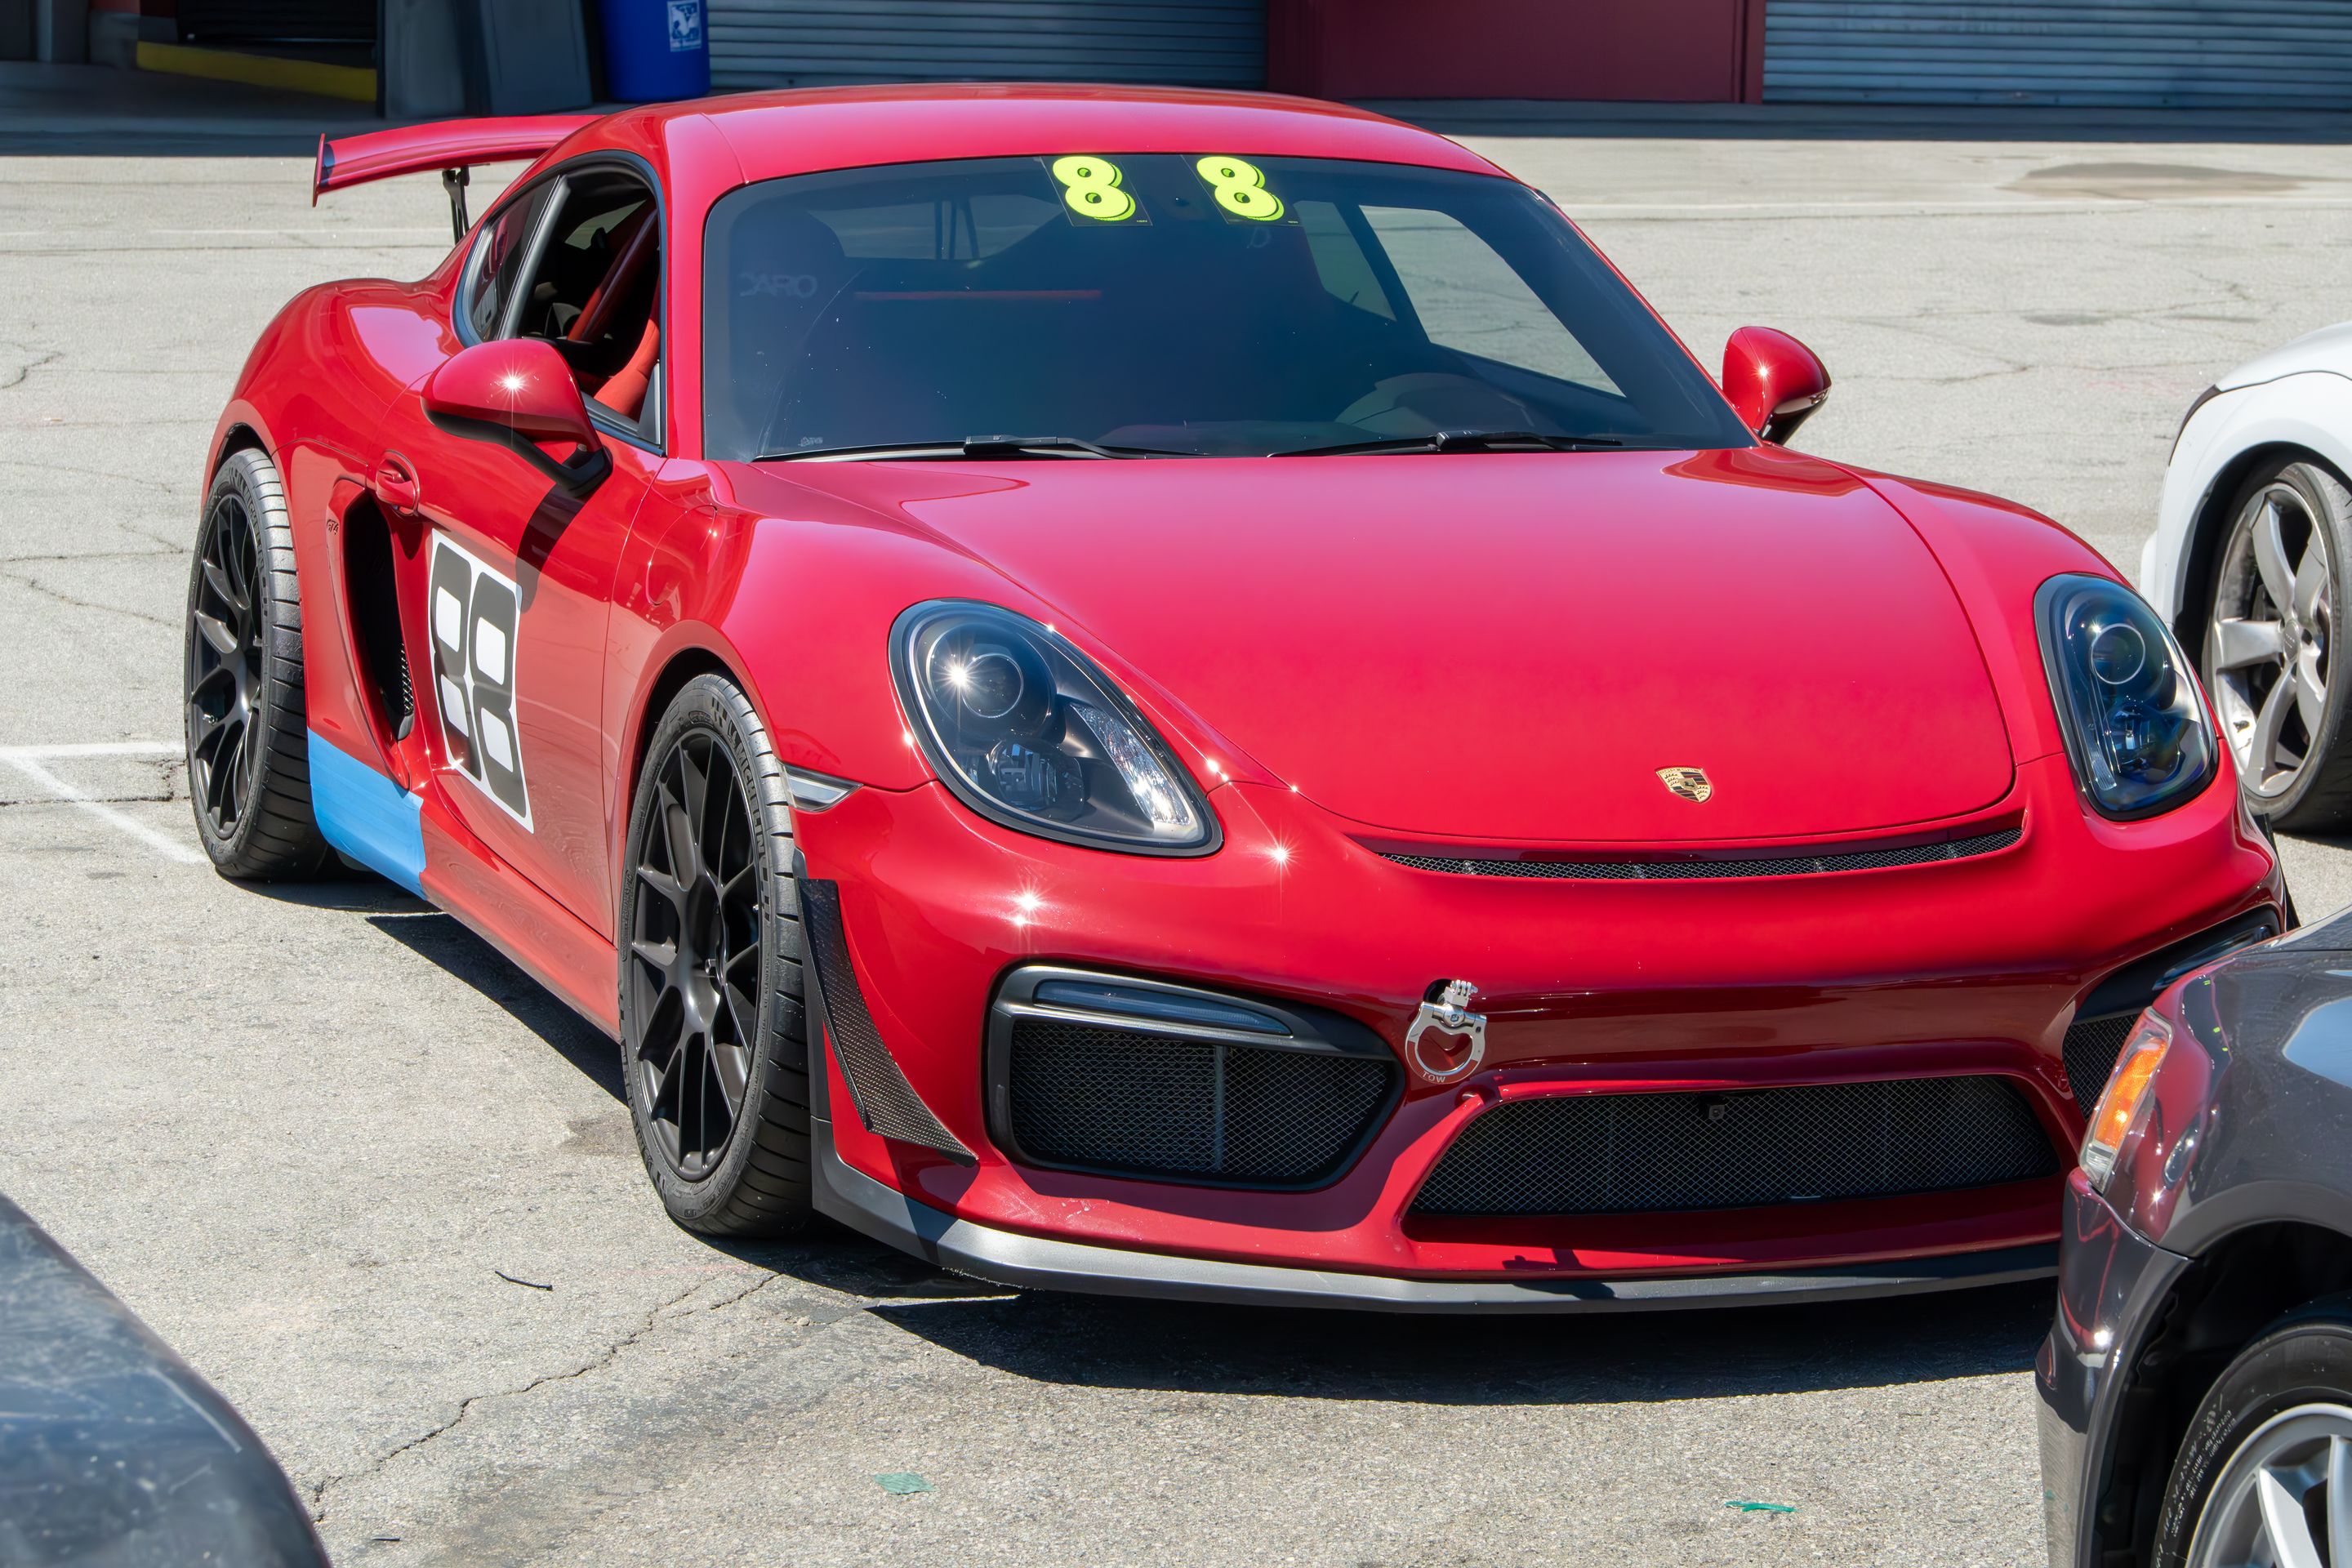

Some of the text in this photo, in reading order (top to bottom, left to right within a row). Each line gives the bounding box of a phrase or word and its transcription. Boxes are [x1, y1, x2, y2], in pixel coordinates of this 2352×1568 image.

[1053, 156, 1285, 221] 8 8
[430, 541, 527, 818] 88
[1423, 1071, 1446, 1083] TOW
